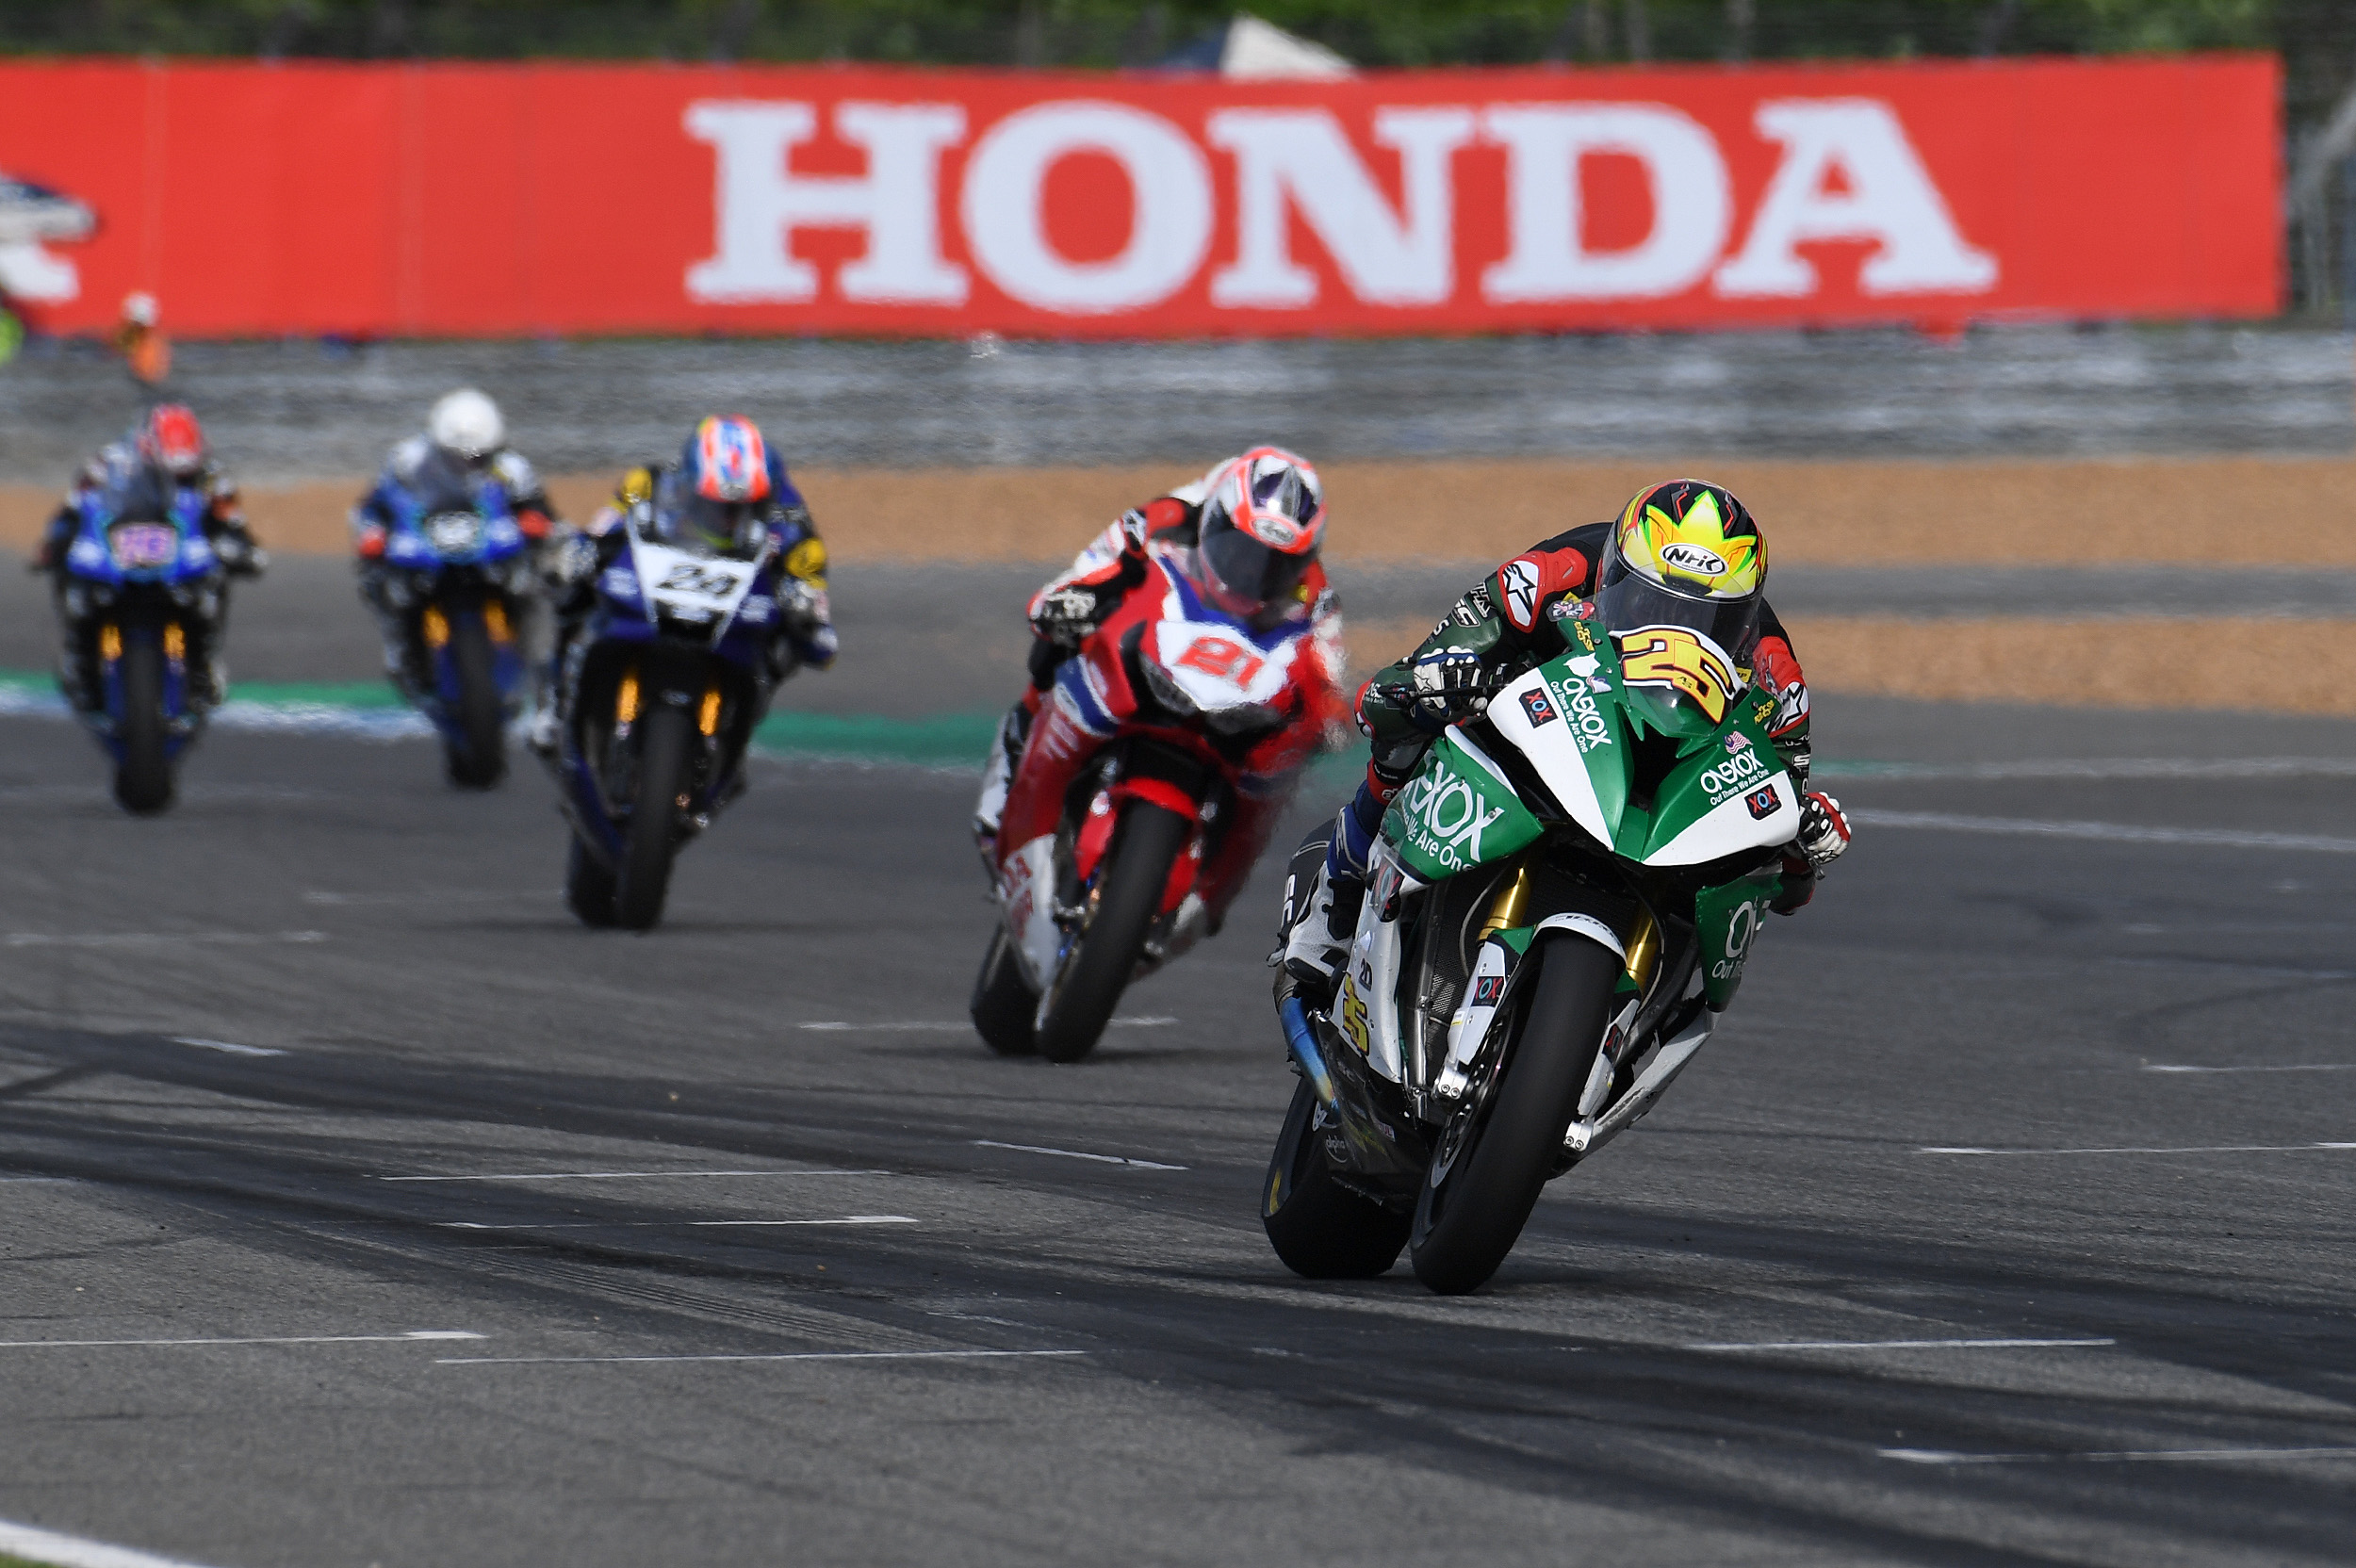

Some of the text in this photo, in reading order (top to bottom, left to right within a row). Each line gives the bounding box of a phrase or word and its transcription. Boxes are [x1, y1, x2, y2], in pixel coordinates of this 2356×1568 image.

[683, 97, 1998, 316] HONDA
[1175, 635, 1266, 693] 21
[1526, 692, 1553, 722] XOX
[1550, 681, 1588, 753] Out There We Are One
[1710, 768, 1770, 806] Out There We Are One
[1748, 788, 1776, 814] XOX
[1415, 829, 1440, 858] Are
[1711, 959, 1735, 979] Out
